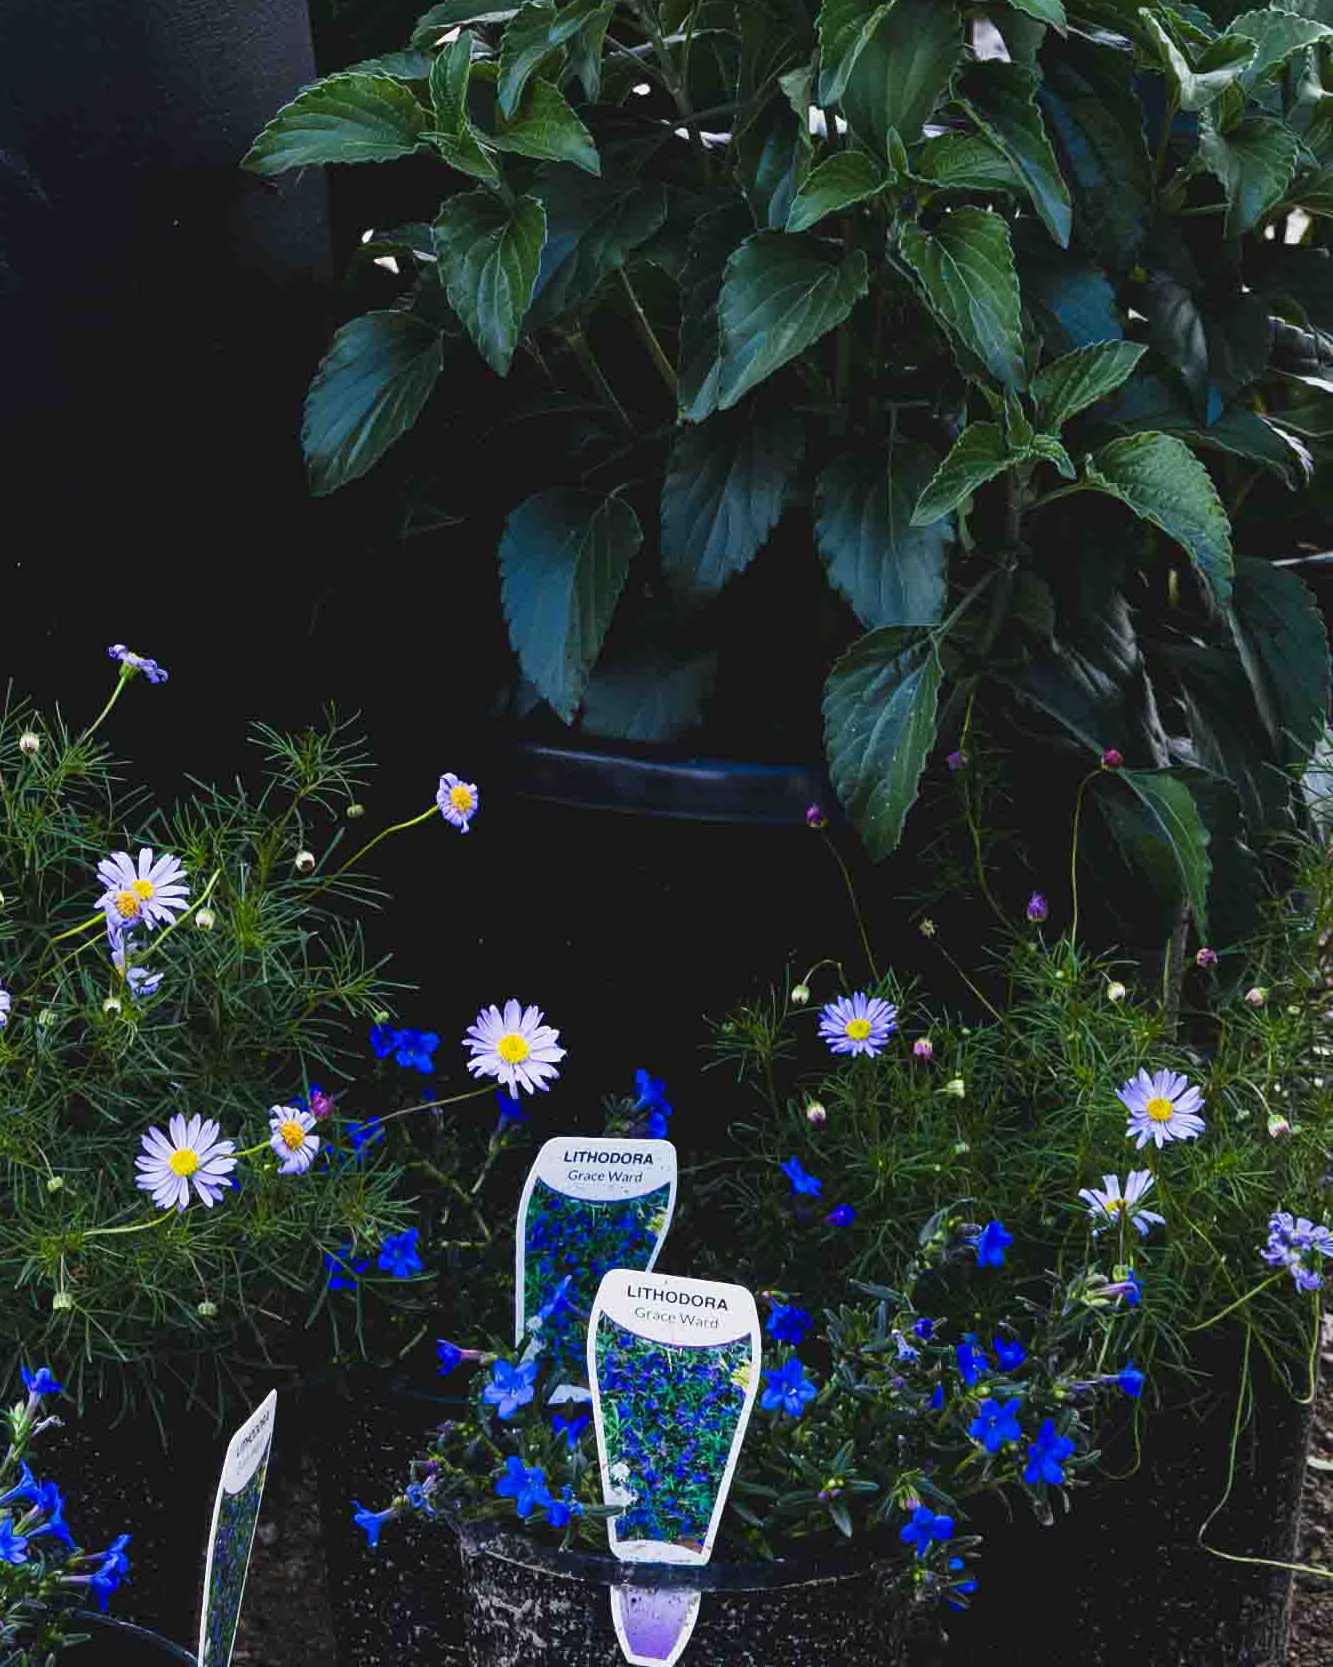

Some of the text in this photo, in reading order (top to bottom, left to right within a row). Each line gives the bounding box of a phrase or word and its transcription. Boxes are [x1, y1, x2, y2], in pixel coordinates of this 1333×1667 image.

[564, 1150, 654, 1165] LITHODORA
[568, 1169, 644, 1183] Grace Ward
[627, 1285, 728, 1310] LITHODORA
[635, 1307, 719, 1329] Grace Ward
